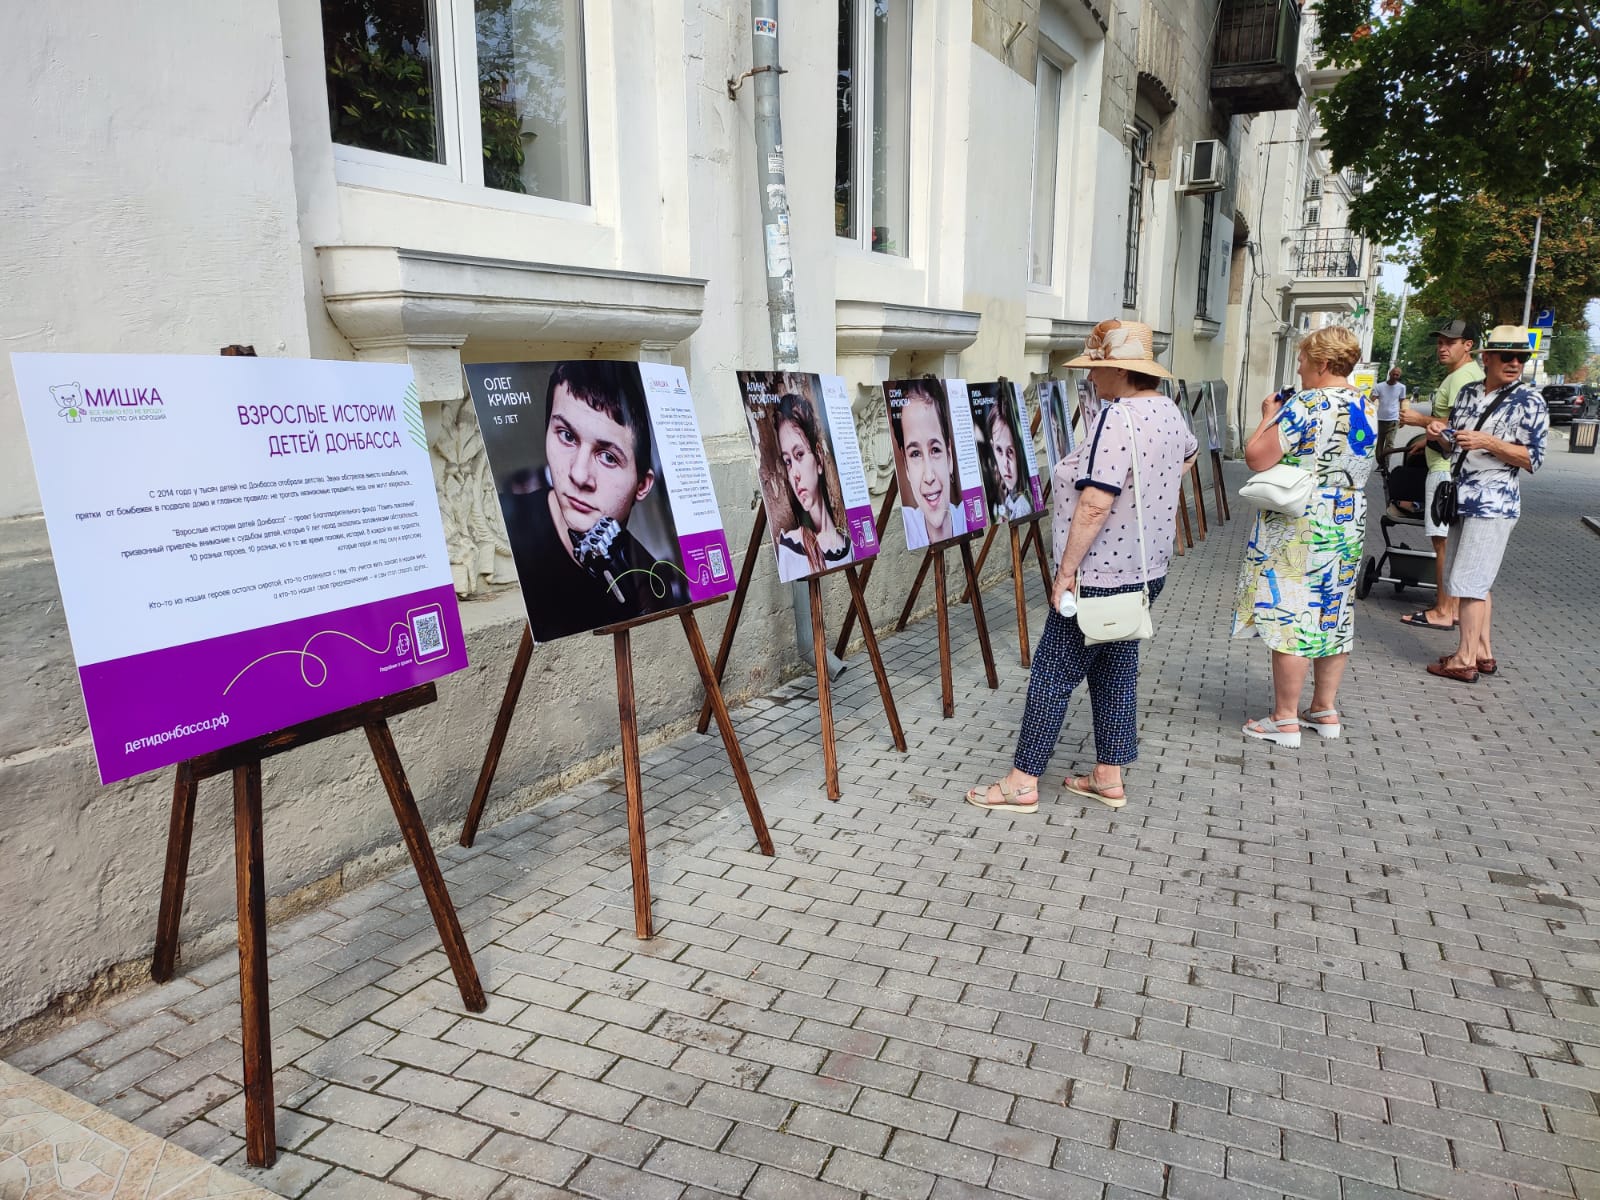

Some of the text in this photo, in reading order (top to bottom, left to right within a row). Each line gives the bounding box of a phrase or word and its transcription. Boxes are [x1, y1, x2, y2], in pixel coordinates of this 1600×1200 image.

[484, 377, 512, 391] ОЛЕГ
[85, 388, 163, 407] МИШКА
[487, 391, 532, 407] КРИВУН
[237, 404, 396, 425] ВЗРОСЛЫЕ ИСТОРИИ
[493, 414, 519, 425] 15 ЛЕТ
[268, 430, 402, 457] ДЕТЕЙ ДОНБАССА
[157, 488, 174, 497] 2014
[176, 488, 192, 496] года
[75, 512, 101, 521] прятки
[116, 506, 153, 516] бомбежек
[161, 502, 190, 511] подвале
[125, 712, 230, 755] детидонбасса.рф
